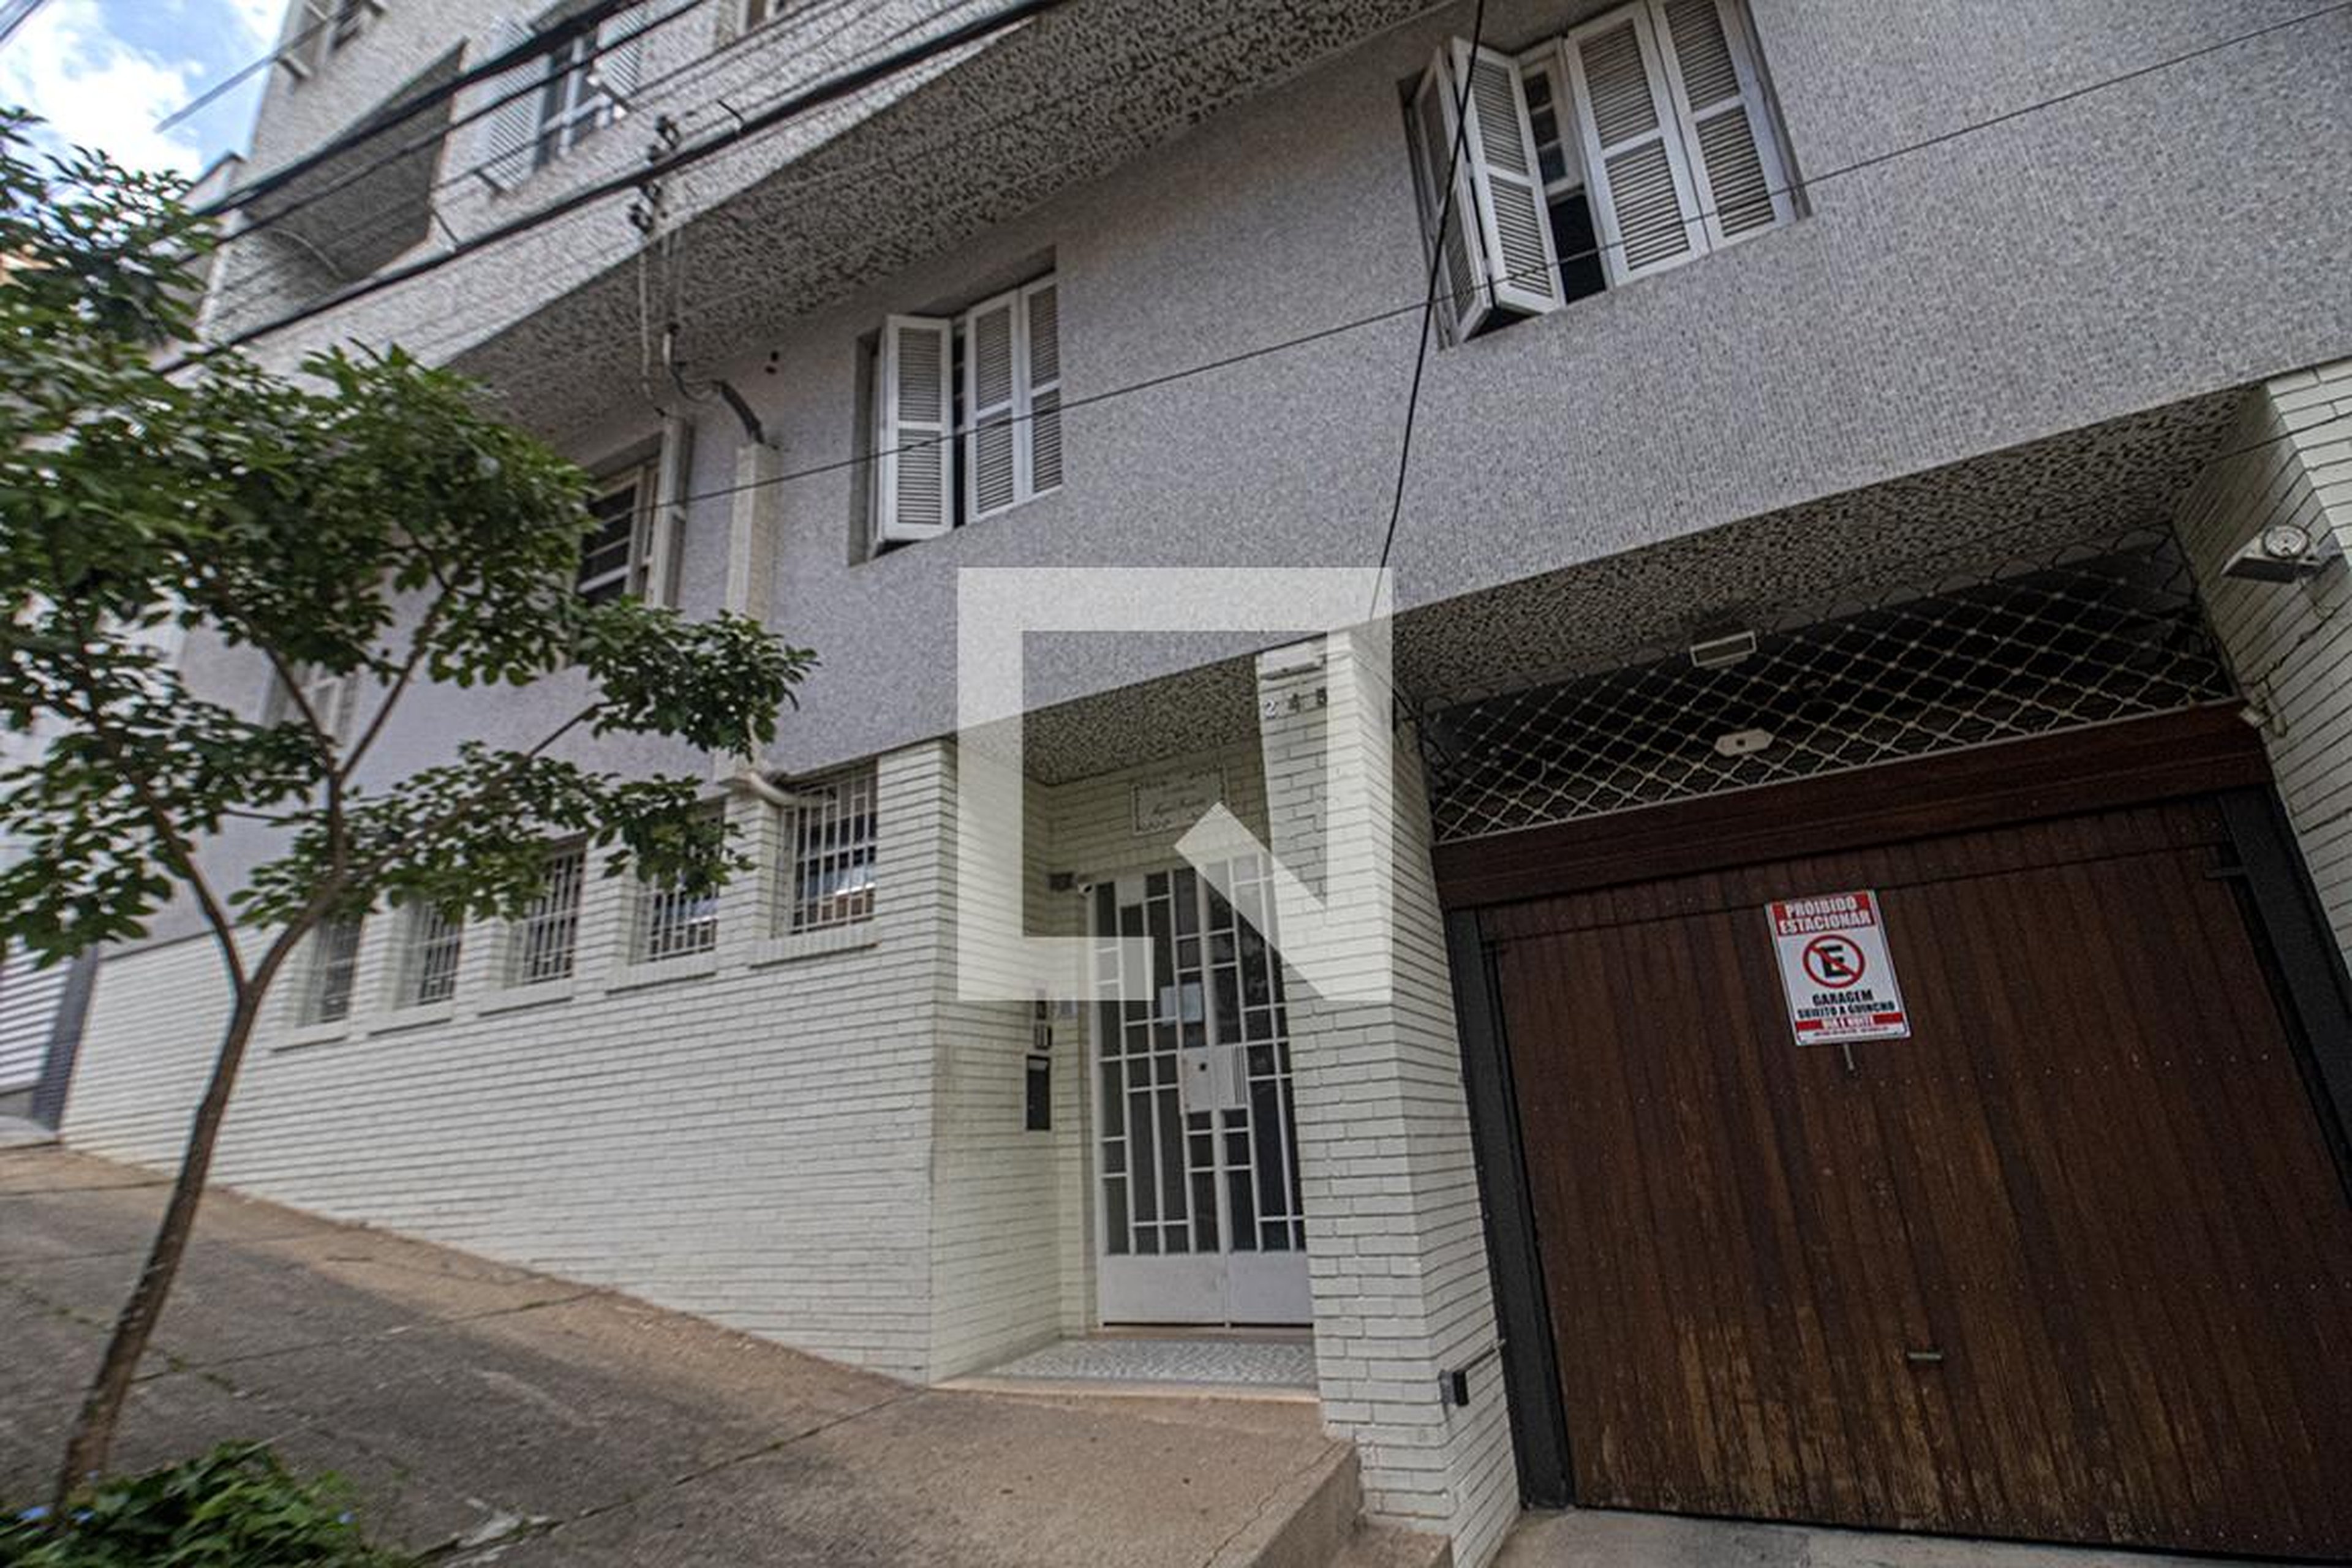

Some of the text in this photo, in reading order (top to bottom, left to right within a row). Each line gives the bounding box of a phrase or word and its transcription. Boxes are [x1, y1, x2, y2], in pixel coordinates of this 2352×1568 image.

[1785, 895, 1858, 918] PROIBIDO
[1779, 910, 1871, 933] ESTACIONAR
[1812, 989, 1874, 1006] GARAGEM
